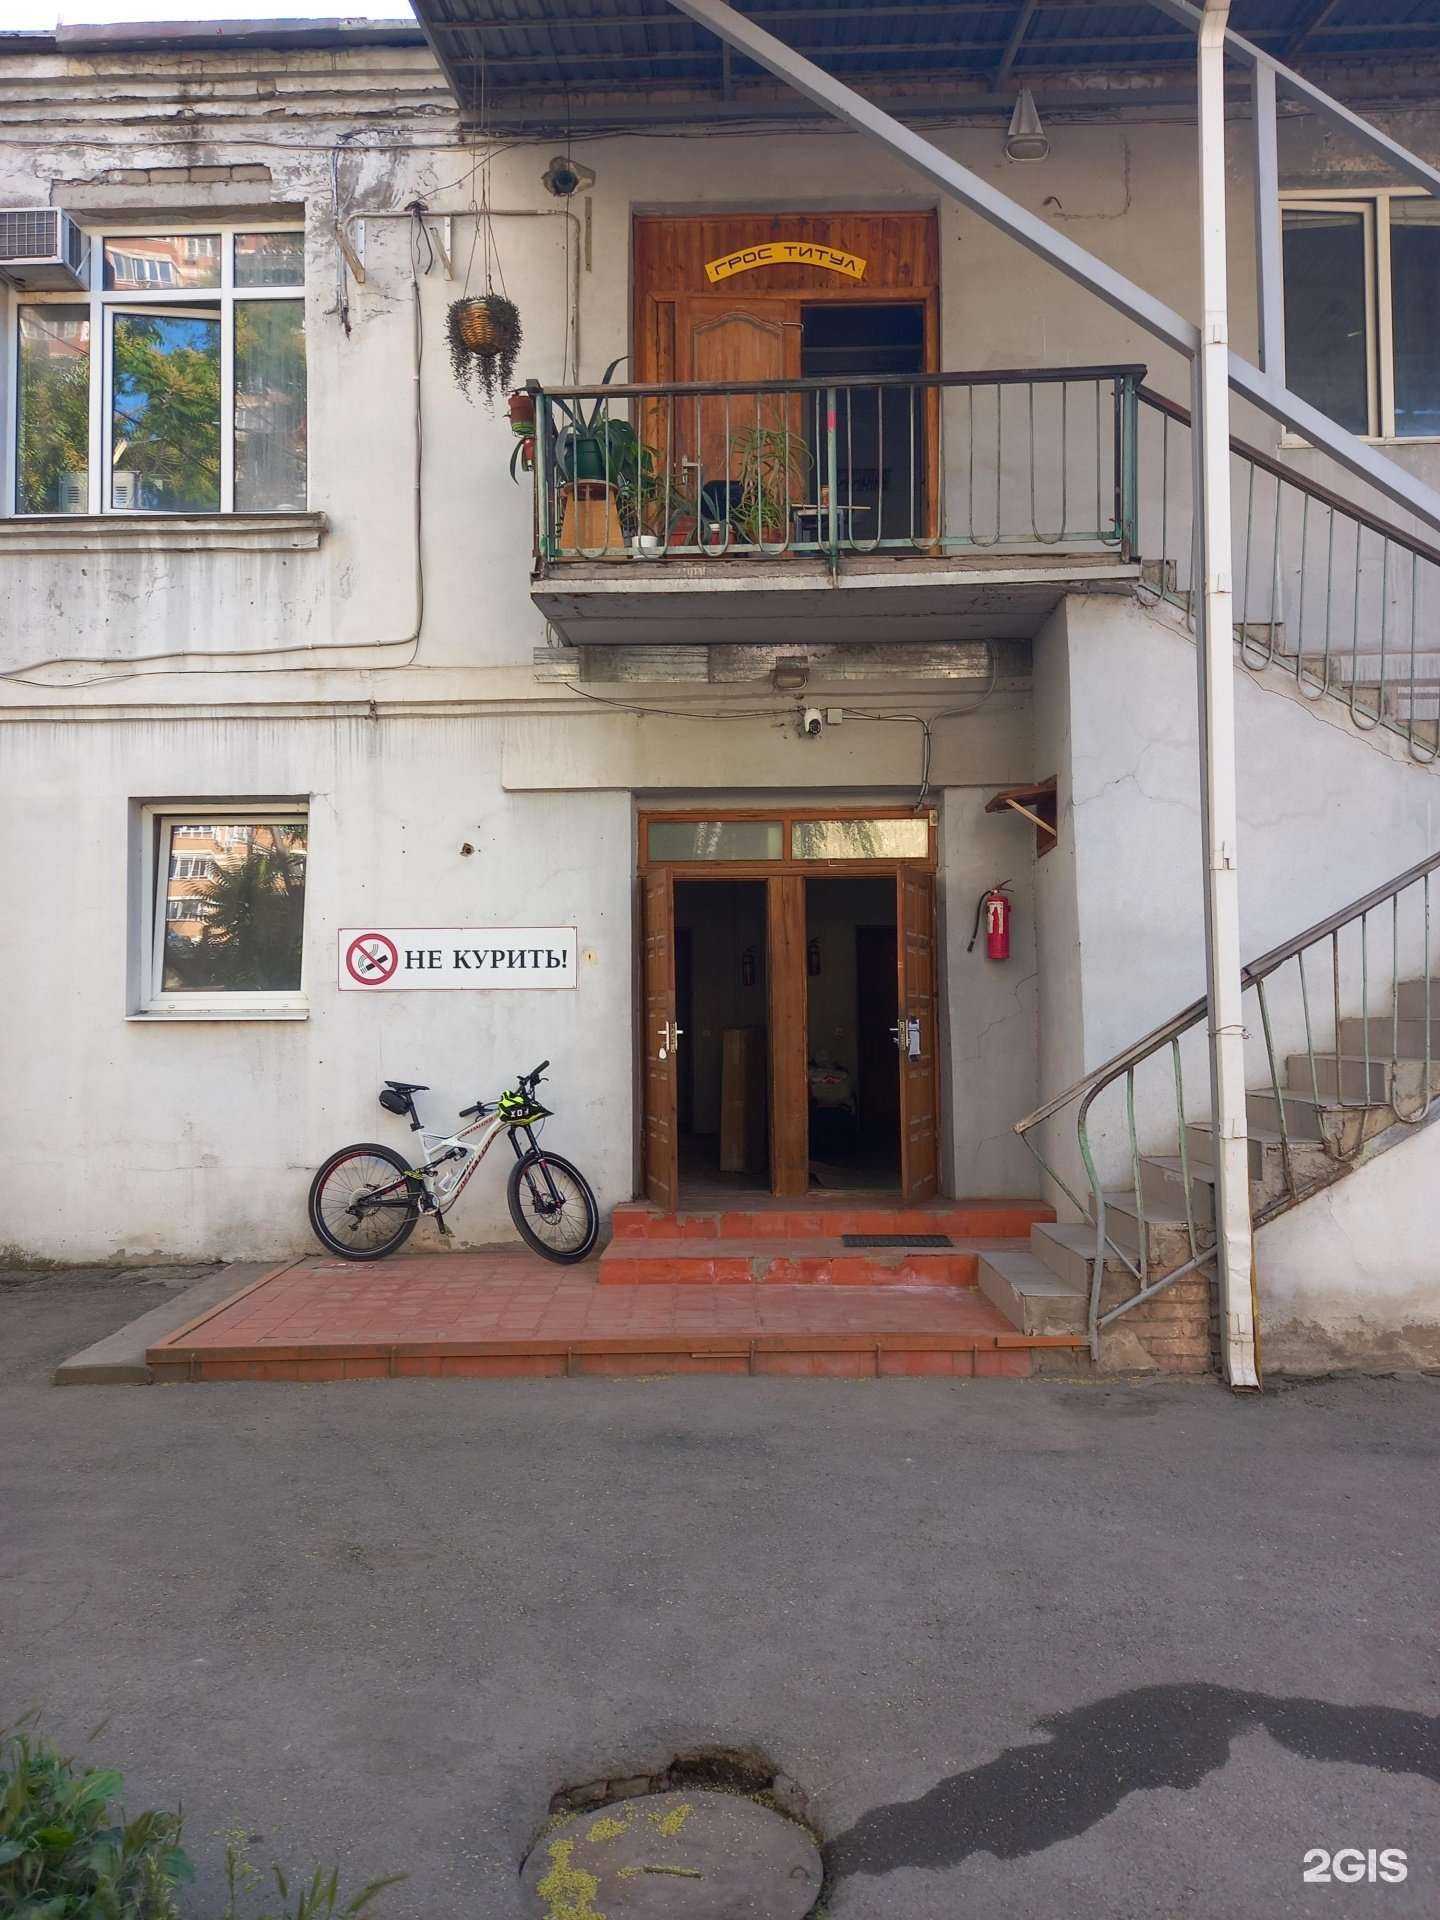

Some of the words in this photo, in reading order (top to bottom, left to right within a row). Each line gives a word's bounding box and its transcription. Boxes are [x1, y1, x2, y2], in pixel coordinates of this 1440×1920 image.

[714, 247, 773, 276] ГРОС
[783, 246, 857, 272] ТИТУЛ
[404, 949, 443, 969] НЕ
[452, 949, 568, 969] КУРИТЬ!
